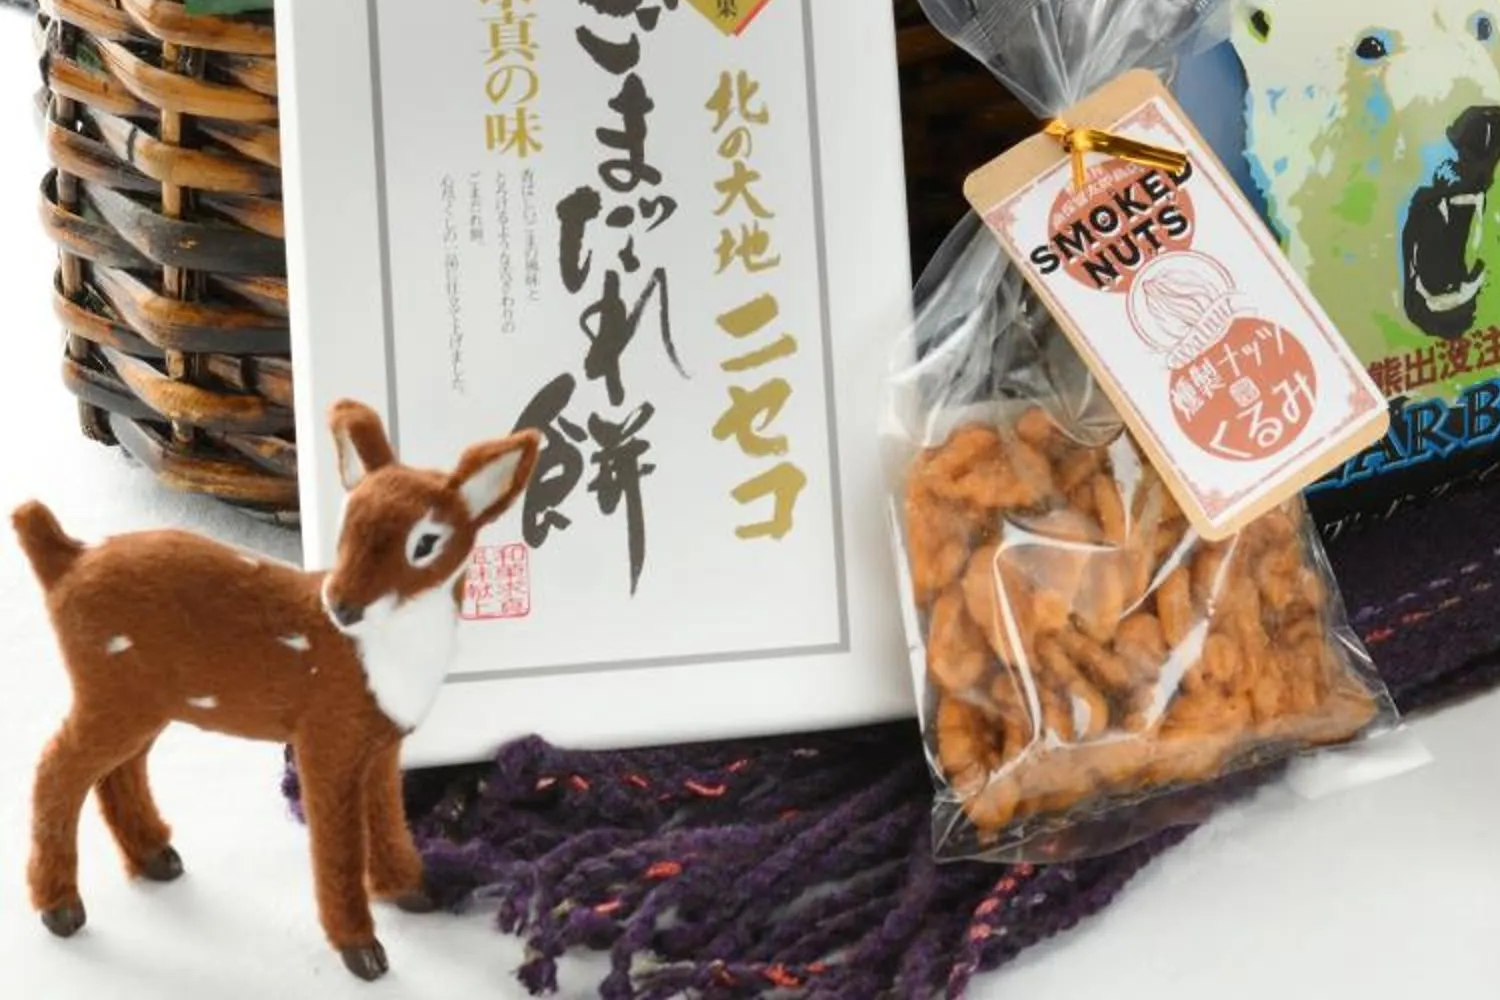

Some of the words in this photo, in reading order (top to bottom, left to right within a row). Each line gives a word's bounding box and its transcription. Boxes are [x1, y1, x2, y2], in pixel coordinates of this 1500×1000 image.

[1030, 160, 1194, 276] SMOKED
[1081, 205, 1188, 288] NUTS
[1209, 370, 1319, 459] くるみ
